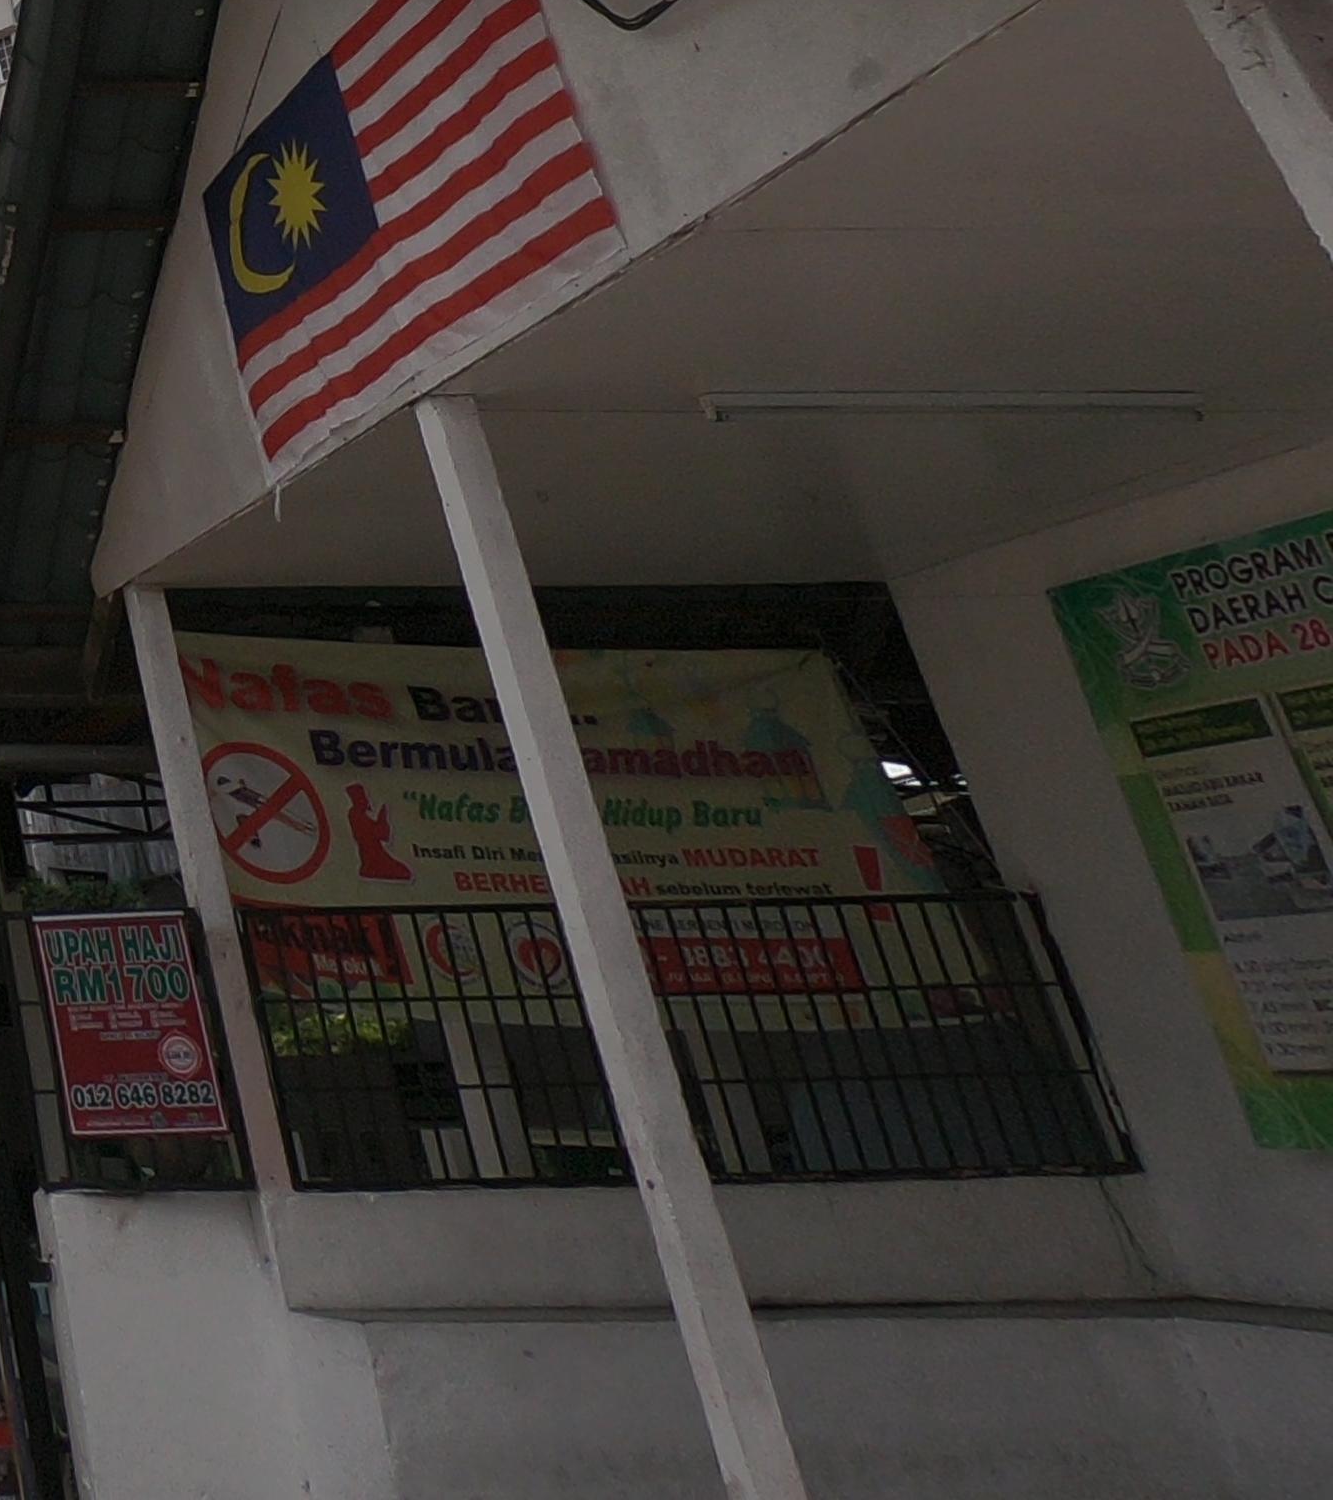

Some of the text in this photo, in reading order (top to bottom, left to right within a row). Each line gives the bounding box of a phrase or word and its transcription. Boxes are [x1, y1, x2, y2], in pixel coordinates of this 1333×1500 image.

[1169, 536, 1324, 600] PROGRAM
[1186, 582, 1307, 635] DAERAH
[1202, 618, 1332, 670] PADA 28
[178, 655, 395, 721] Nafas
[308, 728, 813, 779] Bermula amadhan
[602, 797, 683, 835] Hidup
[681, 848, 821, 868] MUDARAT
[656, 882, 742, 897] sebelum
[42, 924, 185, 966] UPAH HAJI
[72, 1079, 217, 1110] 012 646 8282
